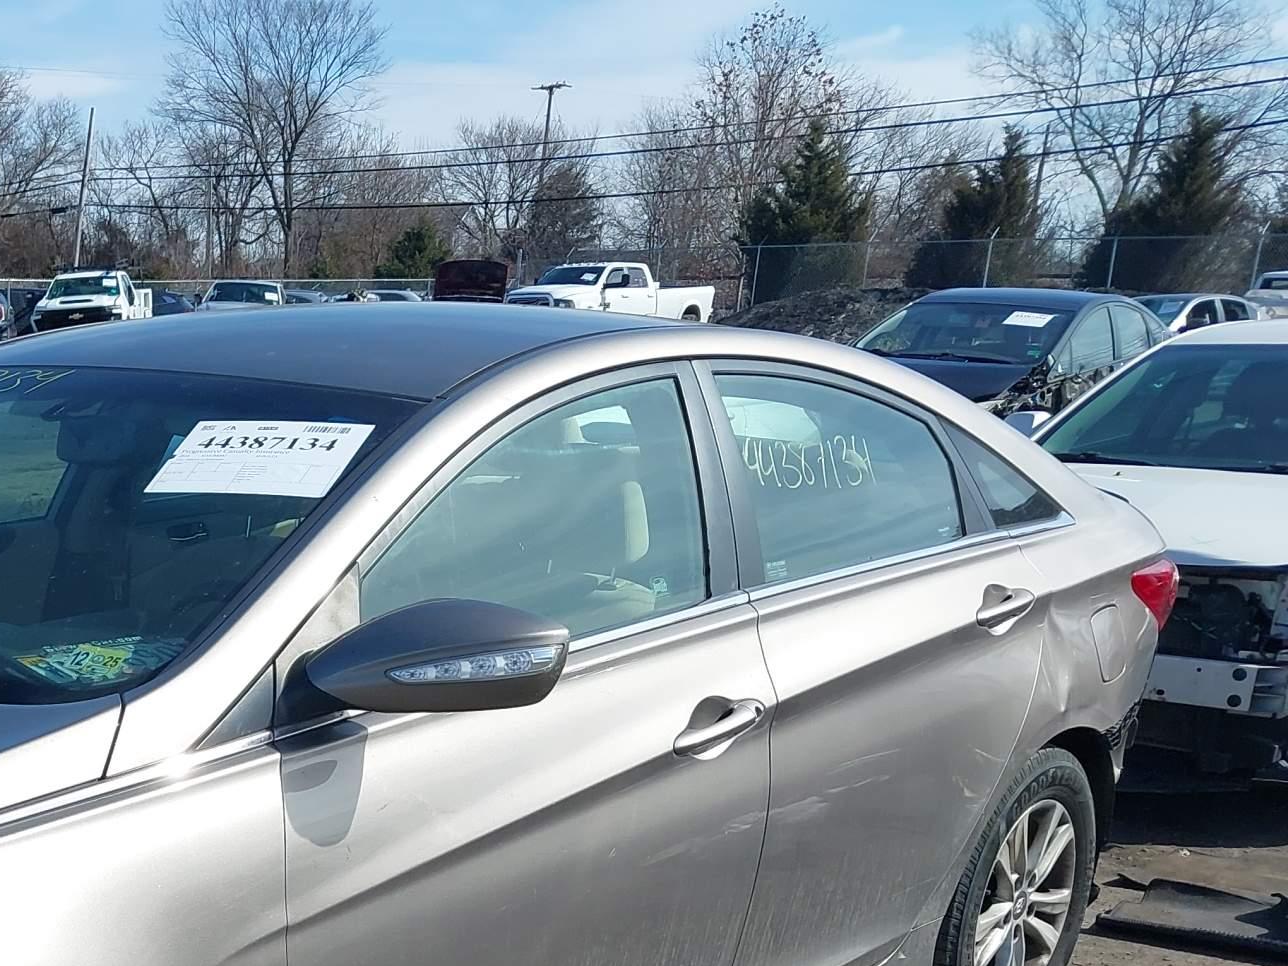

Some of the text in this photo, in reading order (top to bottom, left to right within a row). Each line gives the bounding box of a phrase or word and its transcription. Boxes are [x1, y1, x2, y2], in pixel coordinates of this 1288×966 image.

[198, 435, 340, 452] 44387134
[70, 651, 91, 666] 12
[102, 655, 122, 668] 25
